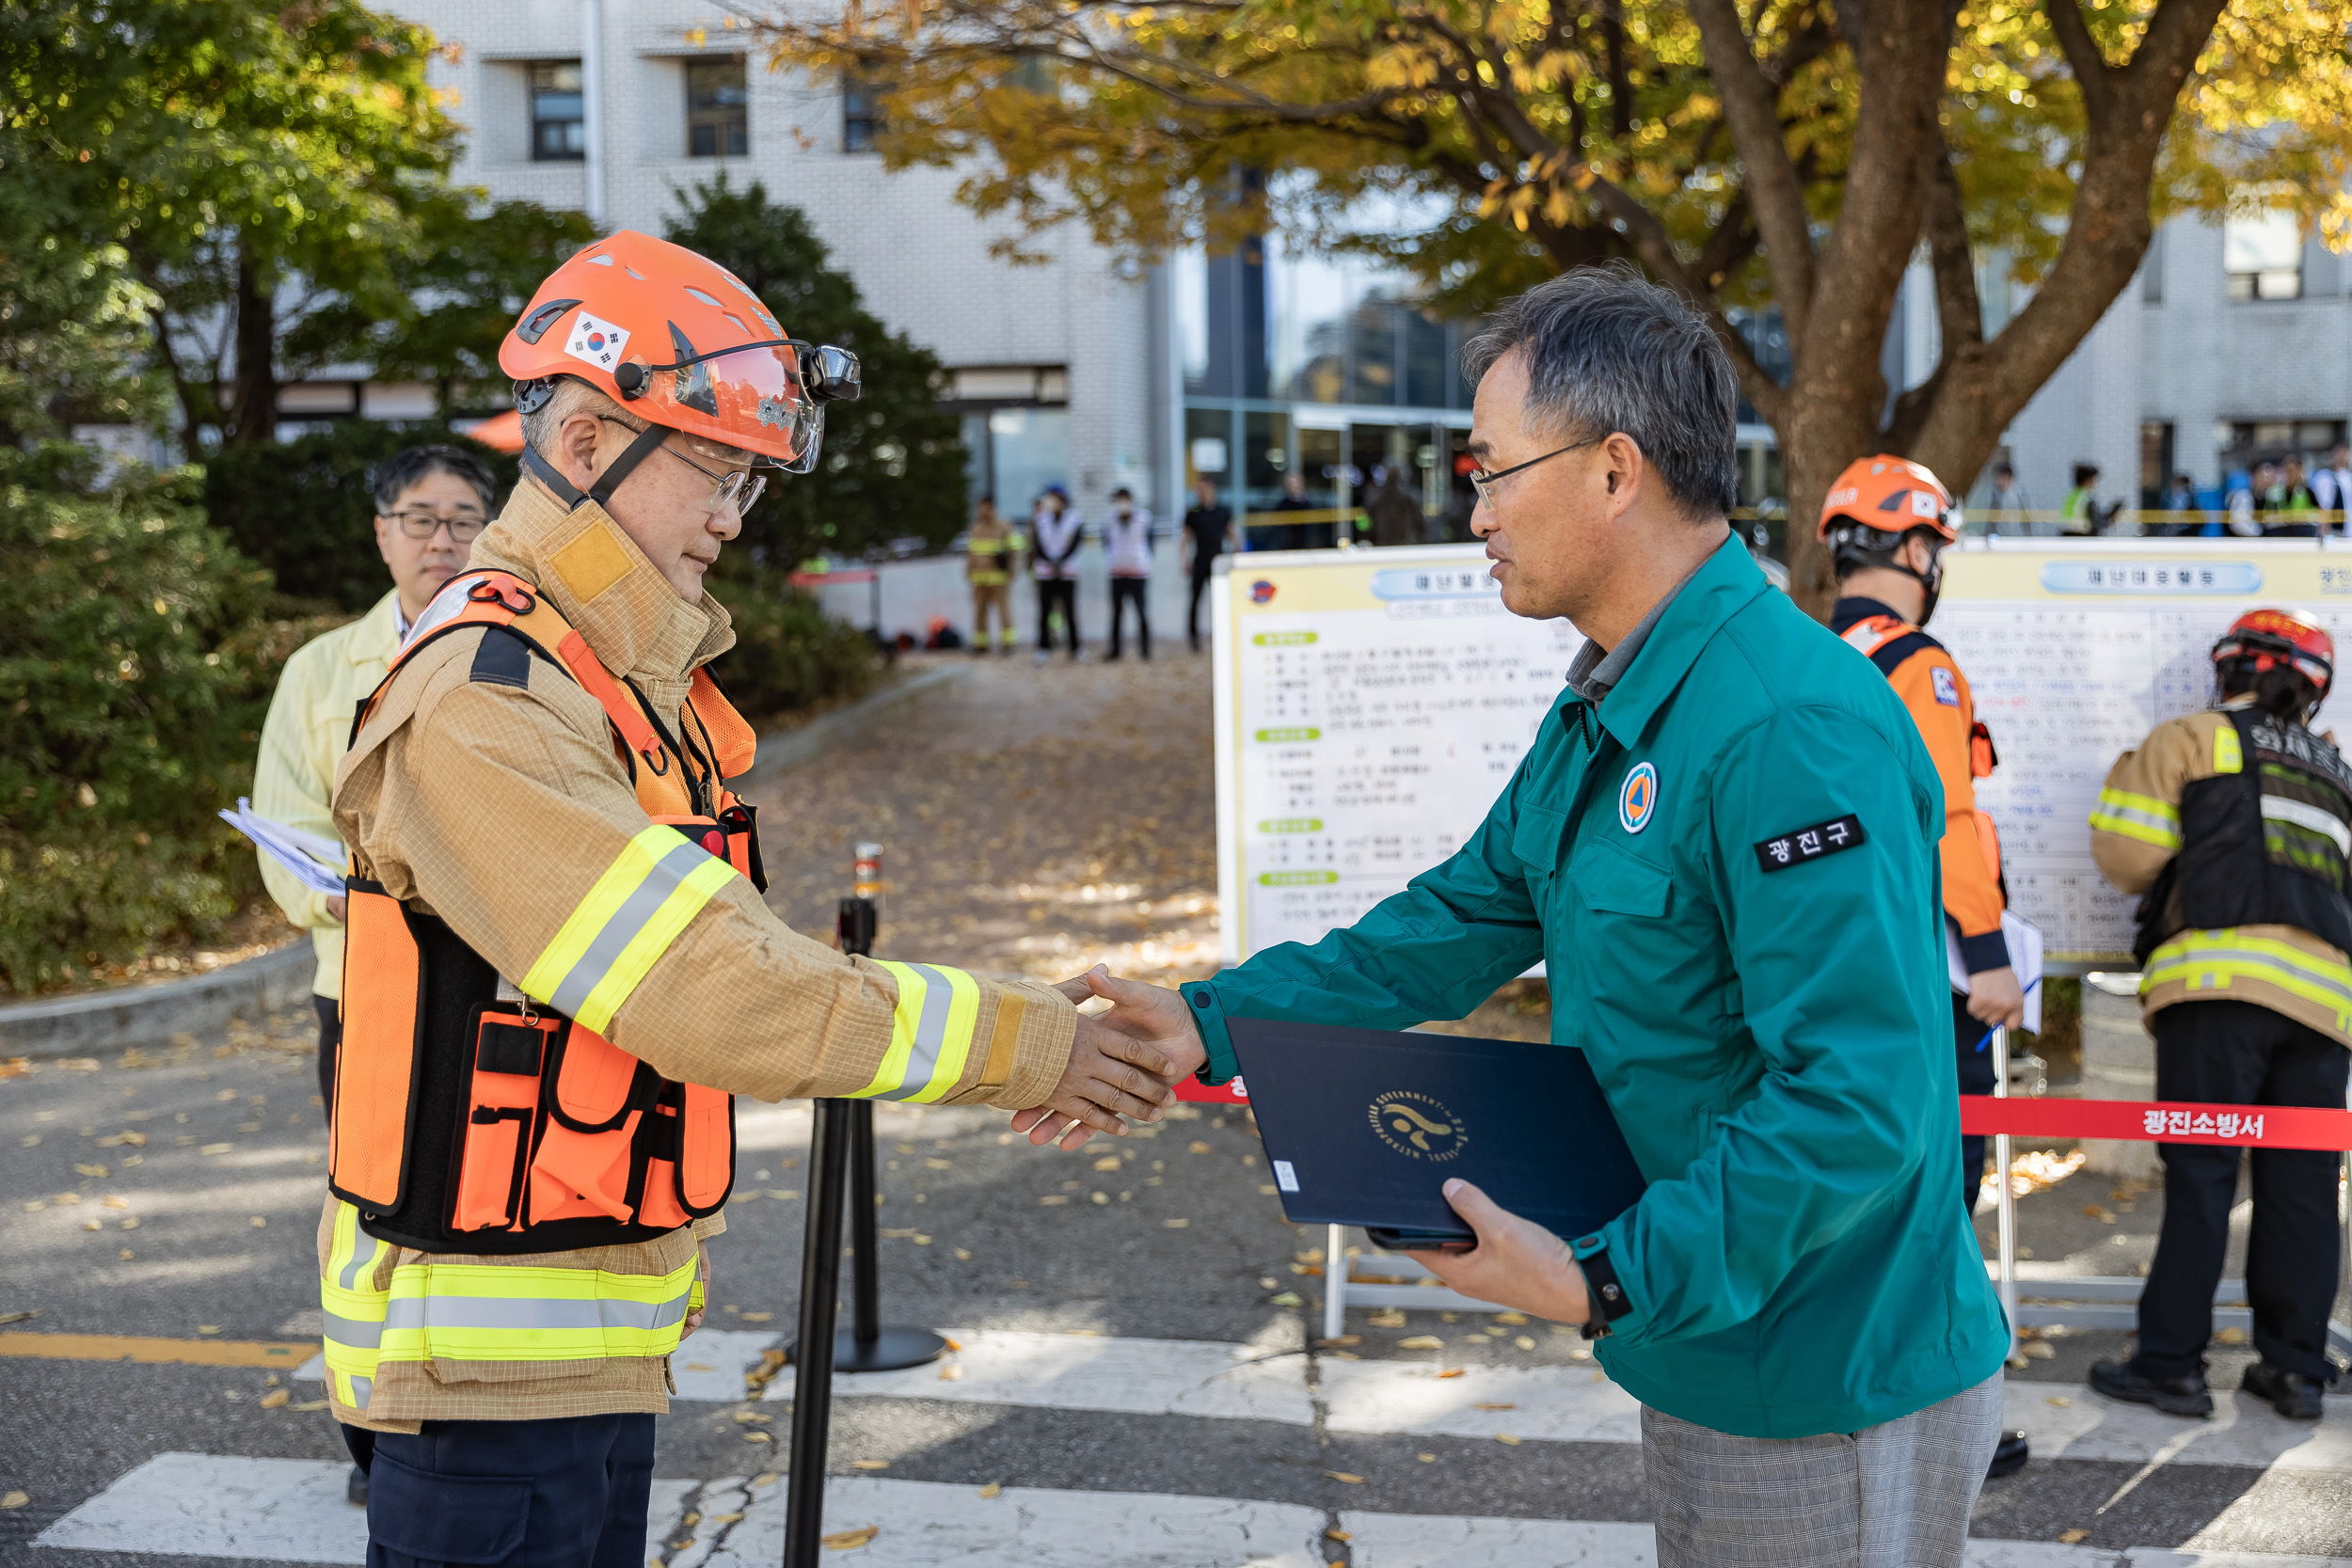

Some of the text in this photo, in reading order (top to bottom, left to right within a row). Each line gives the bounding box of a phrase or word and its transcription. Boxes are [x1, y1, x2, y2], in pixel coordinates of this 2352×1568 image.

[1768, 821, 1849, 863] 광진구
[1375, 1090, 1441, 1108] GOVERNMENT
[2142, 1109, 2265, 1139] 광진소방서
